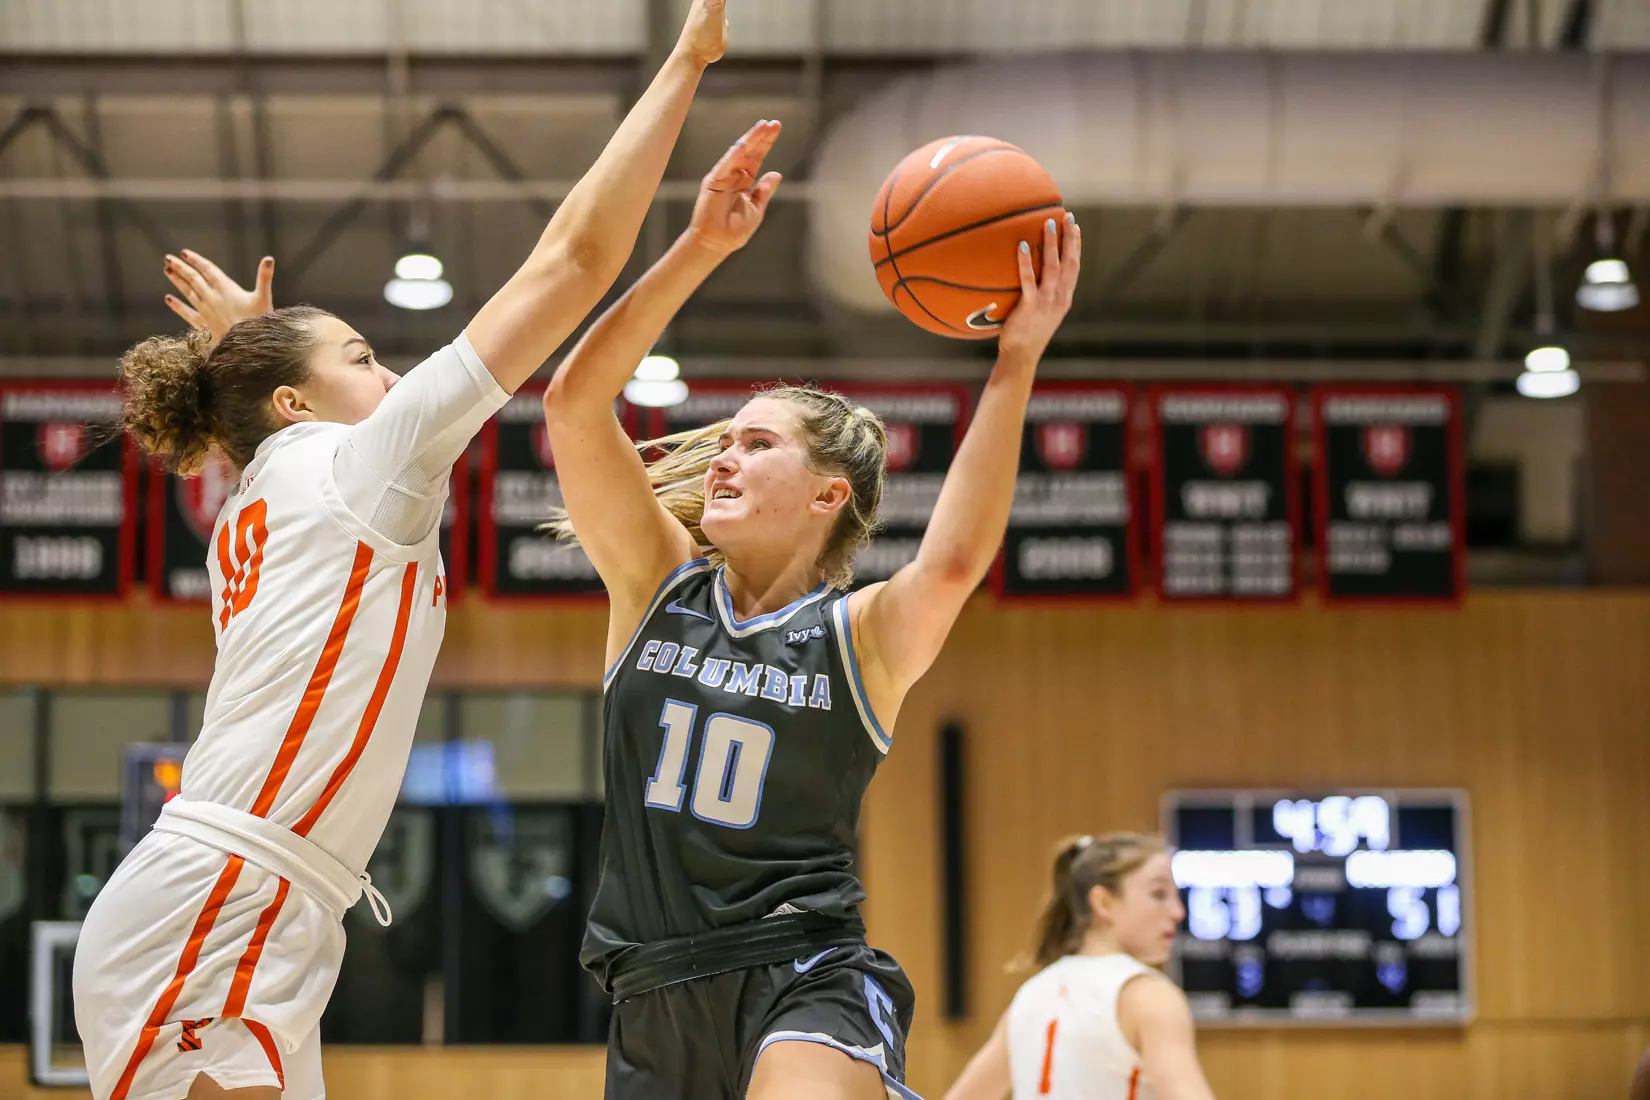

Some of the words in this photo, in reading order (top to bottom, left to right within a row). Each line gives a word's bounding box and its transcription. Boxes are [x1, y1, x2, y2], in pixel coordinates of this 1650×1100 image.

[216, 497, 269, 636] 10
[637, 640, 832, 711] COLUMBIA
[788, 629, 810, 643] Ivy
[645, 698, 775, 830] 10
[1039, 1016, 1060, 1095] 1
